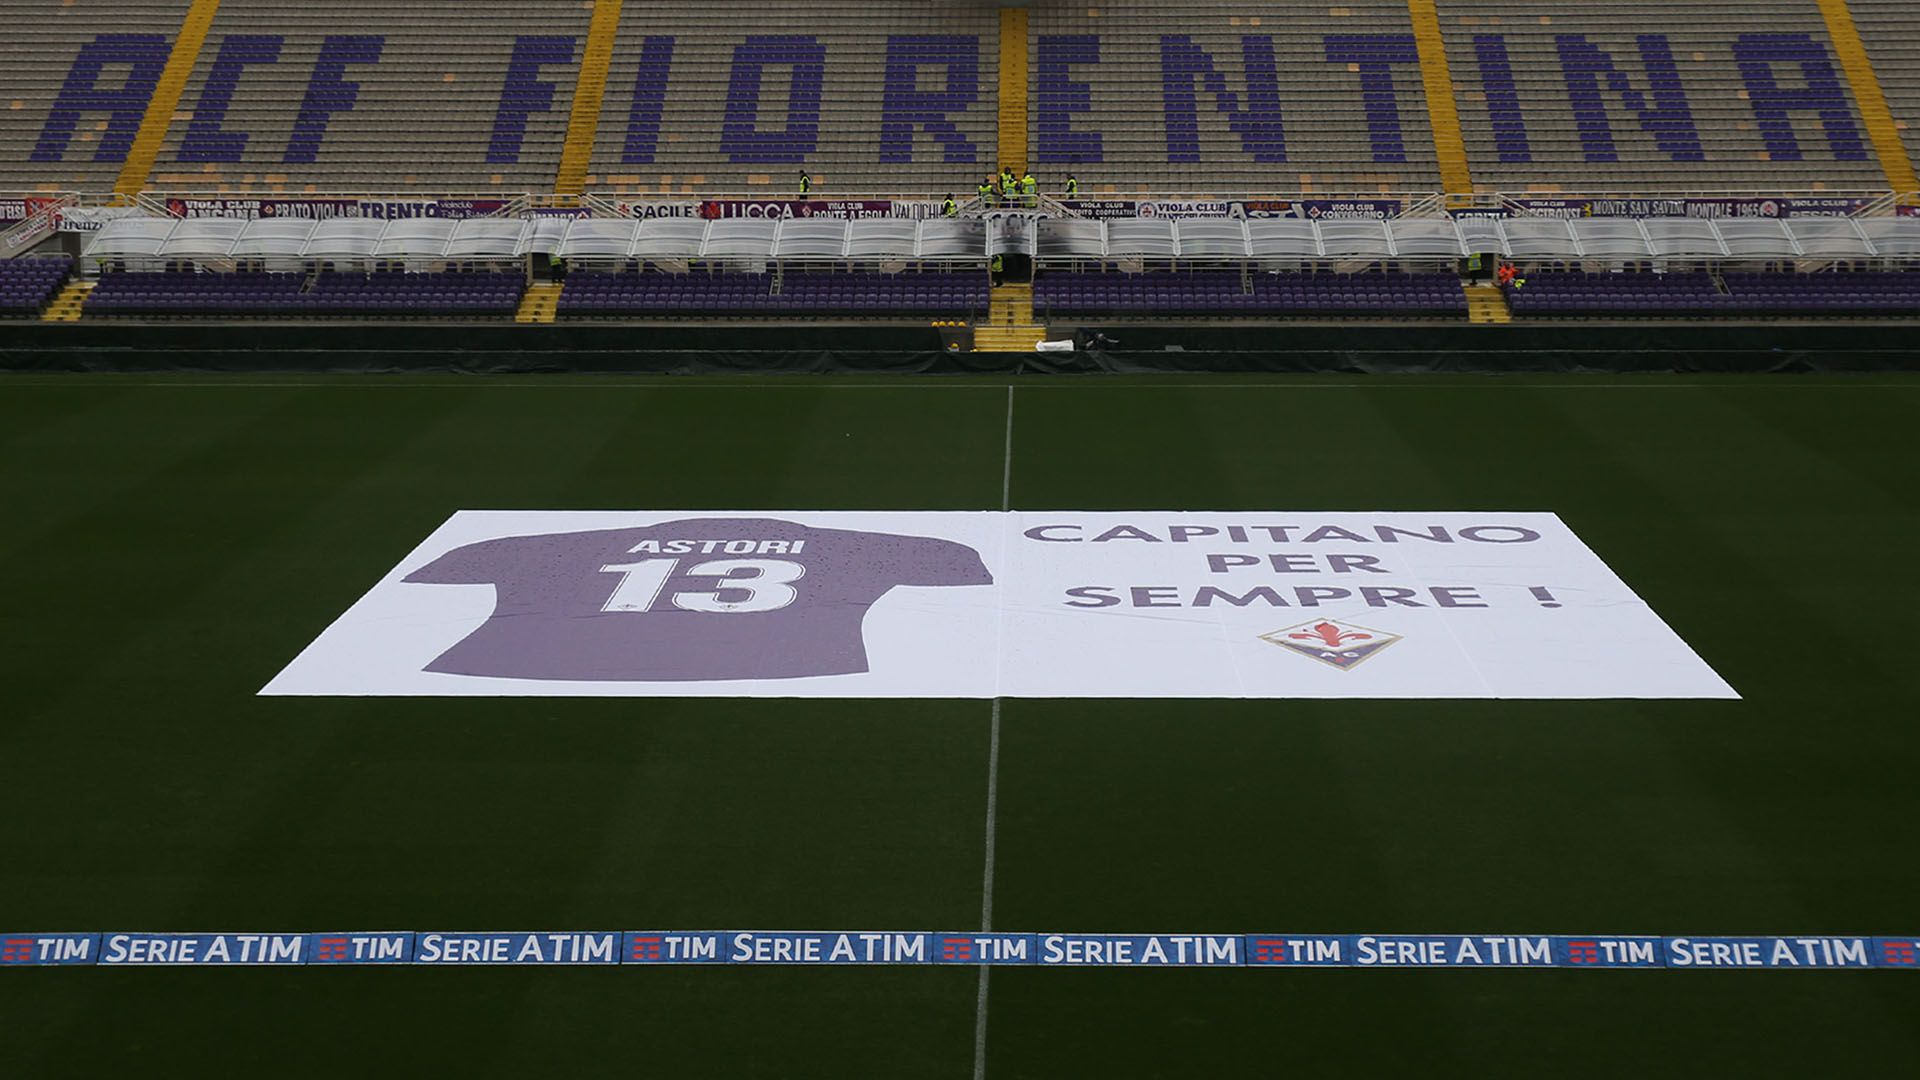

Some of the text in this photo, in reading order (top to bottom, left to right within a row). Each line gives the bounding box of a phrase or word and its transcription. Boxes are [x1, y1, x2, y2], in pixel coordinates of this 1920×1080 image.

[360, 203, 437, 219] TRENTO
[1024, 525, 1540, 543] CAPITANO
[626, 540, 805, 554] ASTORI
[1207, 554, 1391, 573] PER
[598, 557, 806, 613] 13
[1063, 586, 1489, 608] SEMPRE
[37, 939, 90, 960] TIM
[105, 935, 302, 962] SERIE A TIM
[351, 937, 403, 959] TIM
[420, 935, 613, 961] SERIE A TIM
[665, 937, 716, 958] TIM
[732, 934, 924, 961] SERIE A TIM
[975, 938, 1026, 960] TIM
[1043, 936, 1236, 963] SERIE A TIM
[1288, 940, 1340, 961] TIM
[1357, 937, 1552, 964] SERIE A TIM
[1600, 942, 1654, 963] TIM
[1672, 938, 1868, 966] SERIE A TIM
